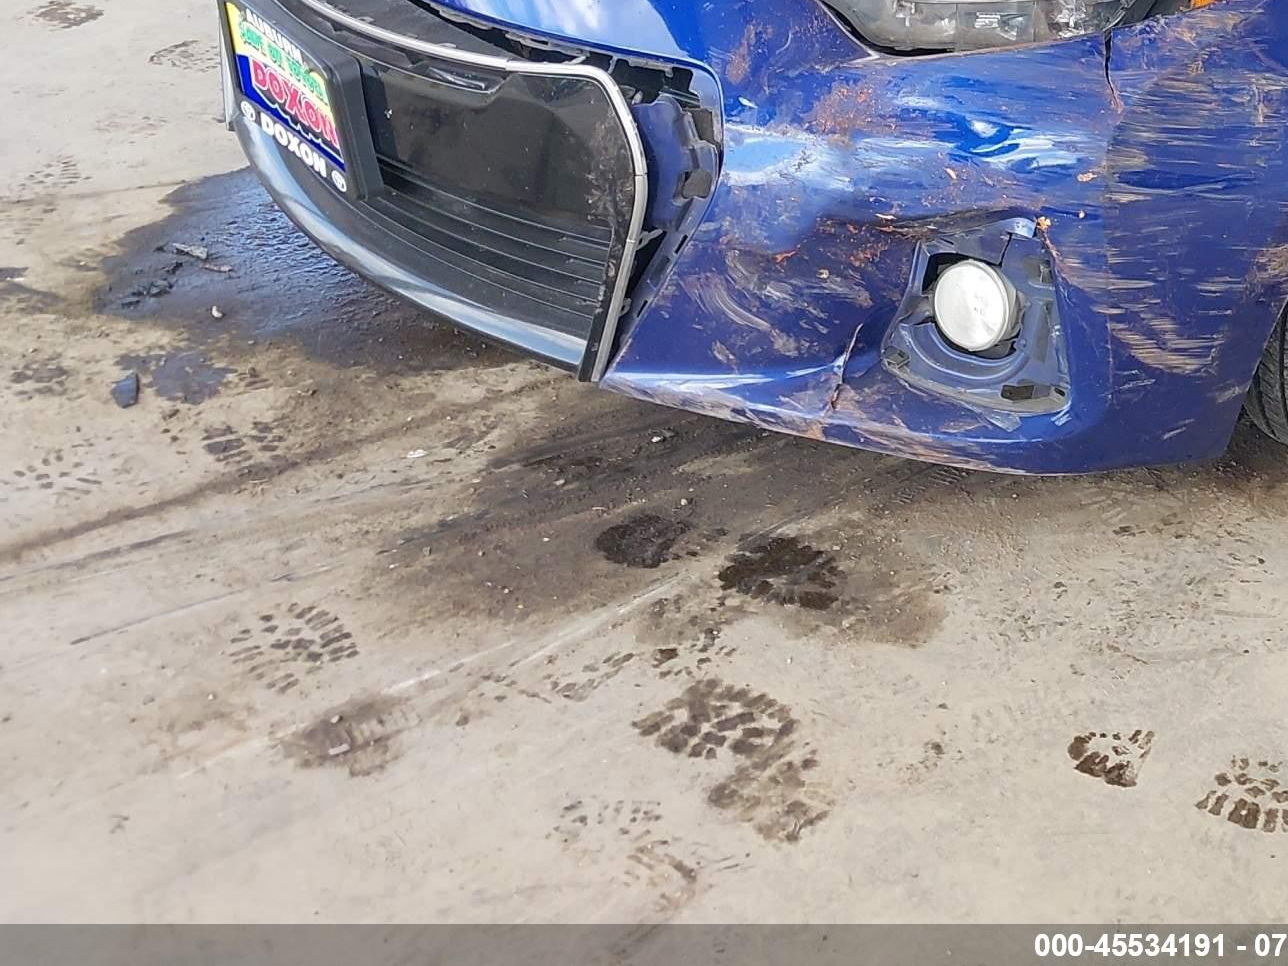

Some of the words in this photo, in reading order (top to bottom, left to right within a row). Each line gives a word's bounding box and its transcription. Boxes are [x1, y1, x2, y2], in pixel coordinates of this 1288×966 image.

[246, 8, 302, 63] AUBURN
[252, 58, 340, 149] DOXON
[261, 113, 328, 178] DOXON
